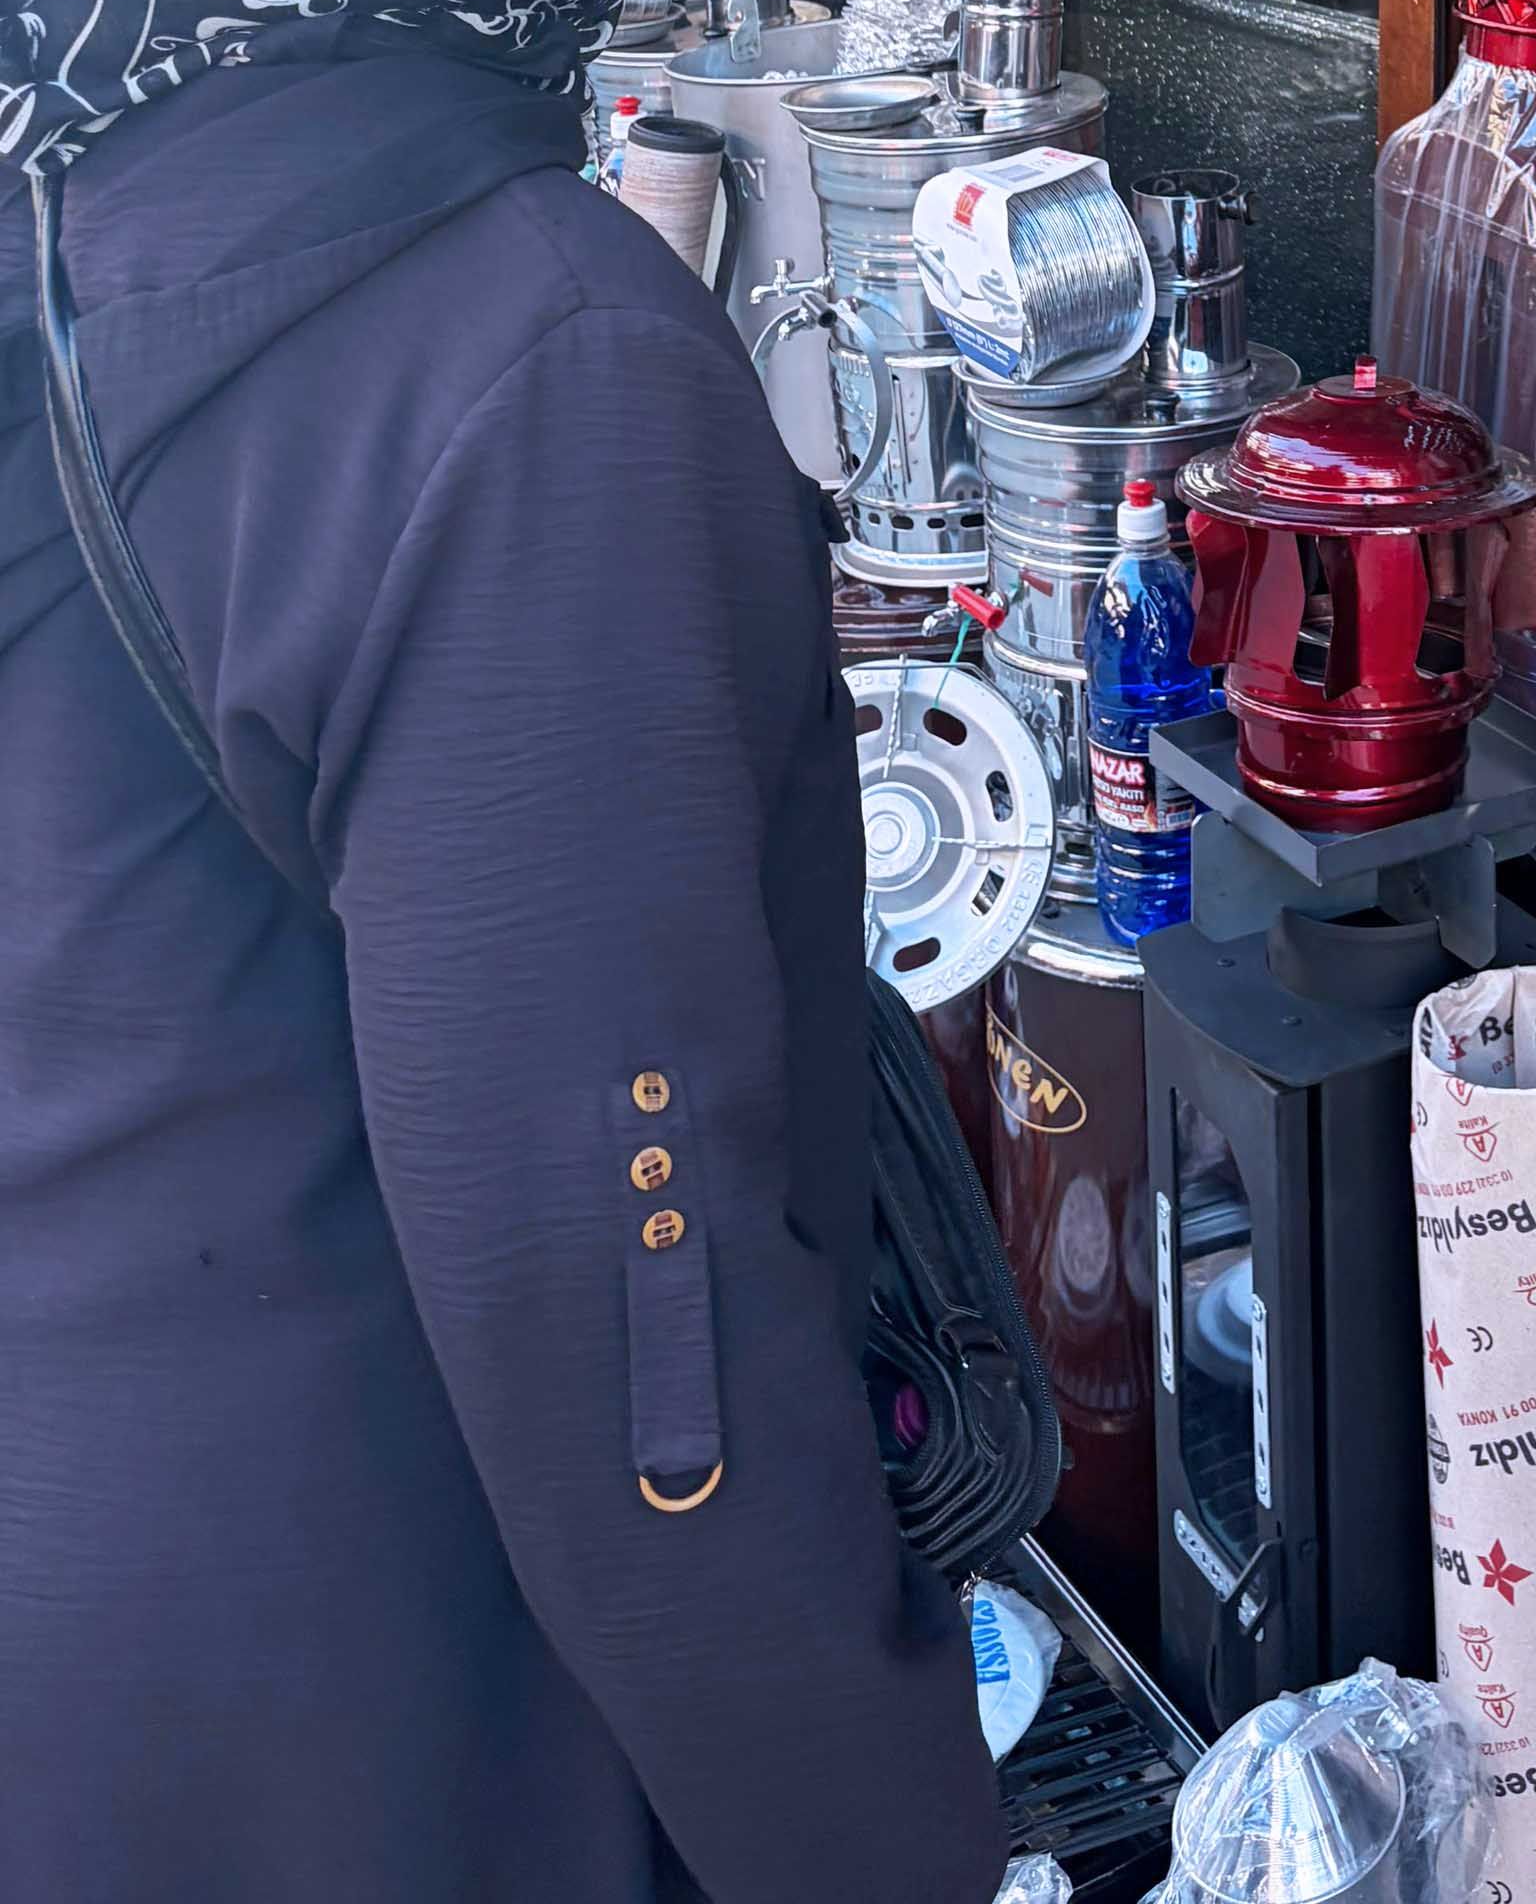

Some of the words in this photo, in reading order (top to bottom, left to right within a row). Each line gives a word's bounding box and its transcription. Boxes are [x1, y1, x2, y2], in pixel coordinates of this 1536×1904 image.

[1472, 1136, 1485, 1153] A
[1466, 1326, 1493, 1353] CE
[1457, 1408, 1499, 1427] KONYA
[1503, 1403, 1520, 1420] 91
[1470, 1644, 1484, 1662] A
[1491, 1699, 1505, 1718] A
